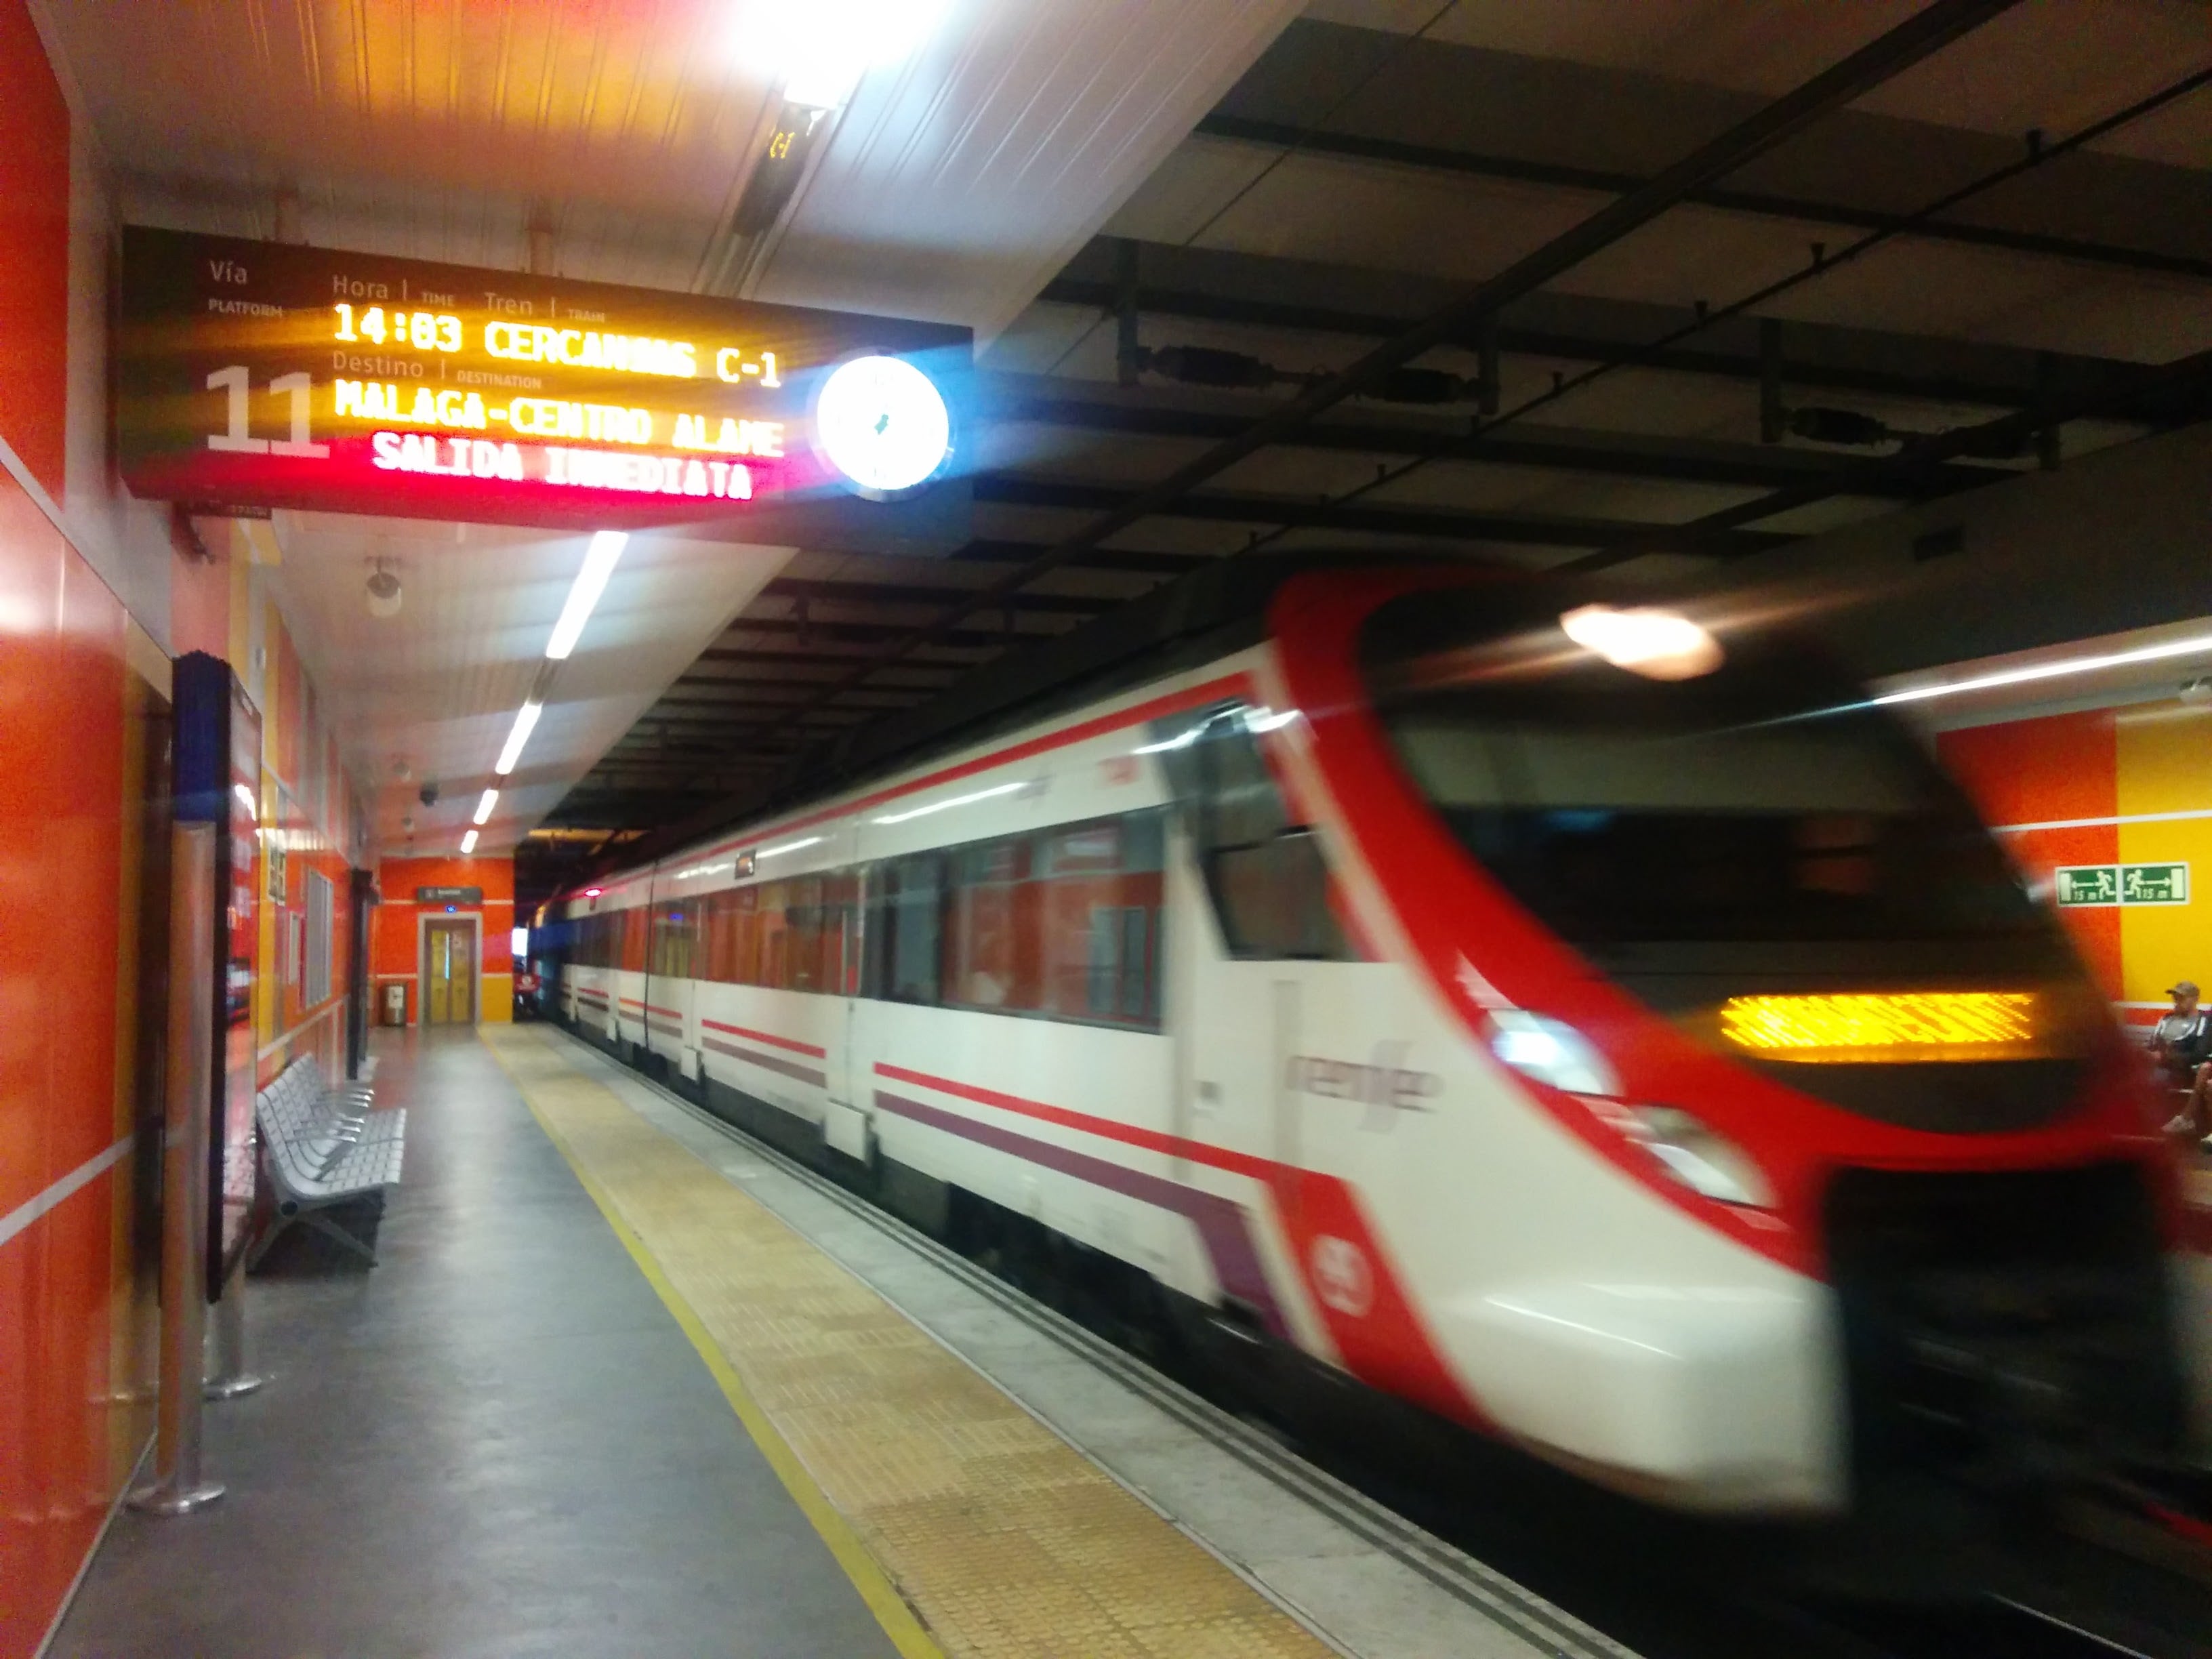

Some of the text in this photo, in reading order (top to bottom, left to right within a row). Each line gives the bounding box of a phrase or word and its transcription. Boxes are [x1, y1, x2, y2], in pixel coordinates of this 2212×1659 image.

[210, 260, 248, 285] Vía
[333, 274, 389, 300] Hora
[422, 291, 456, 307] TIME
[484, 291, 533, 315] Tren
[209, 298, 283, 319] PLATFORM
[334, 304, 462, 352] 14:03
[716, 346, 781, 388] C-1
[333, 350, 541, 390] Destino DESTINATION
[206, 365, 331, 459] 11
[335, 379, 785, 457] MALAGA-CENTRO ALAME
[372, 431, 525, 480] SALIDA
